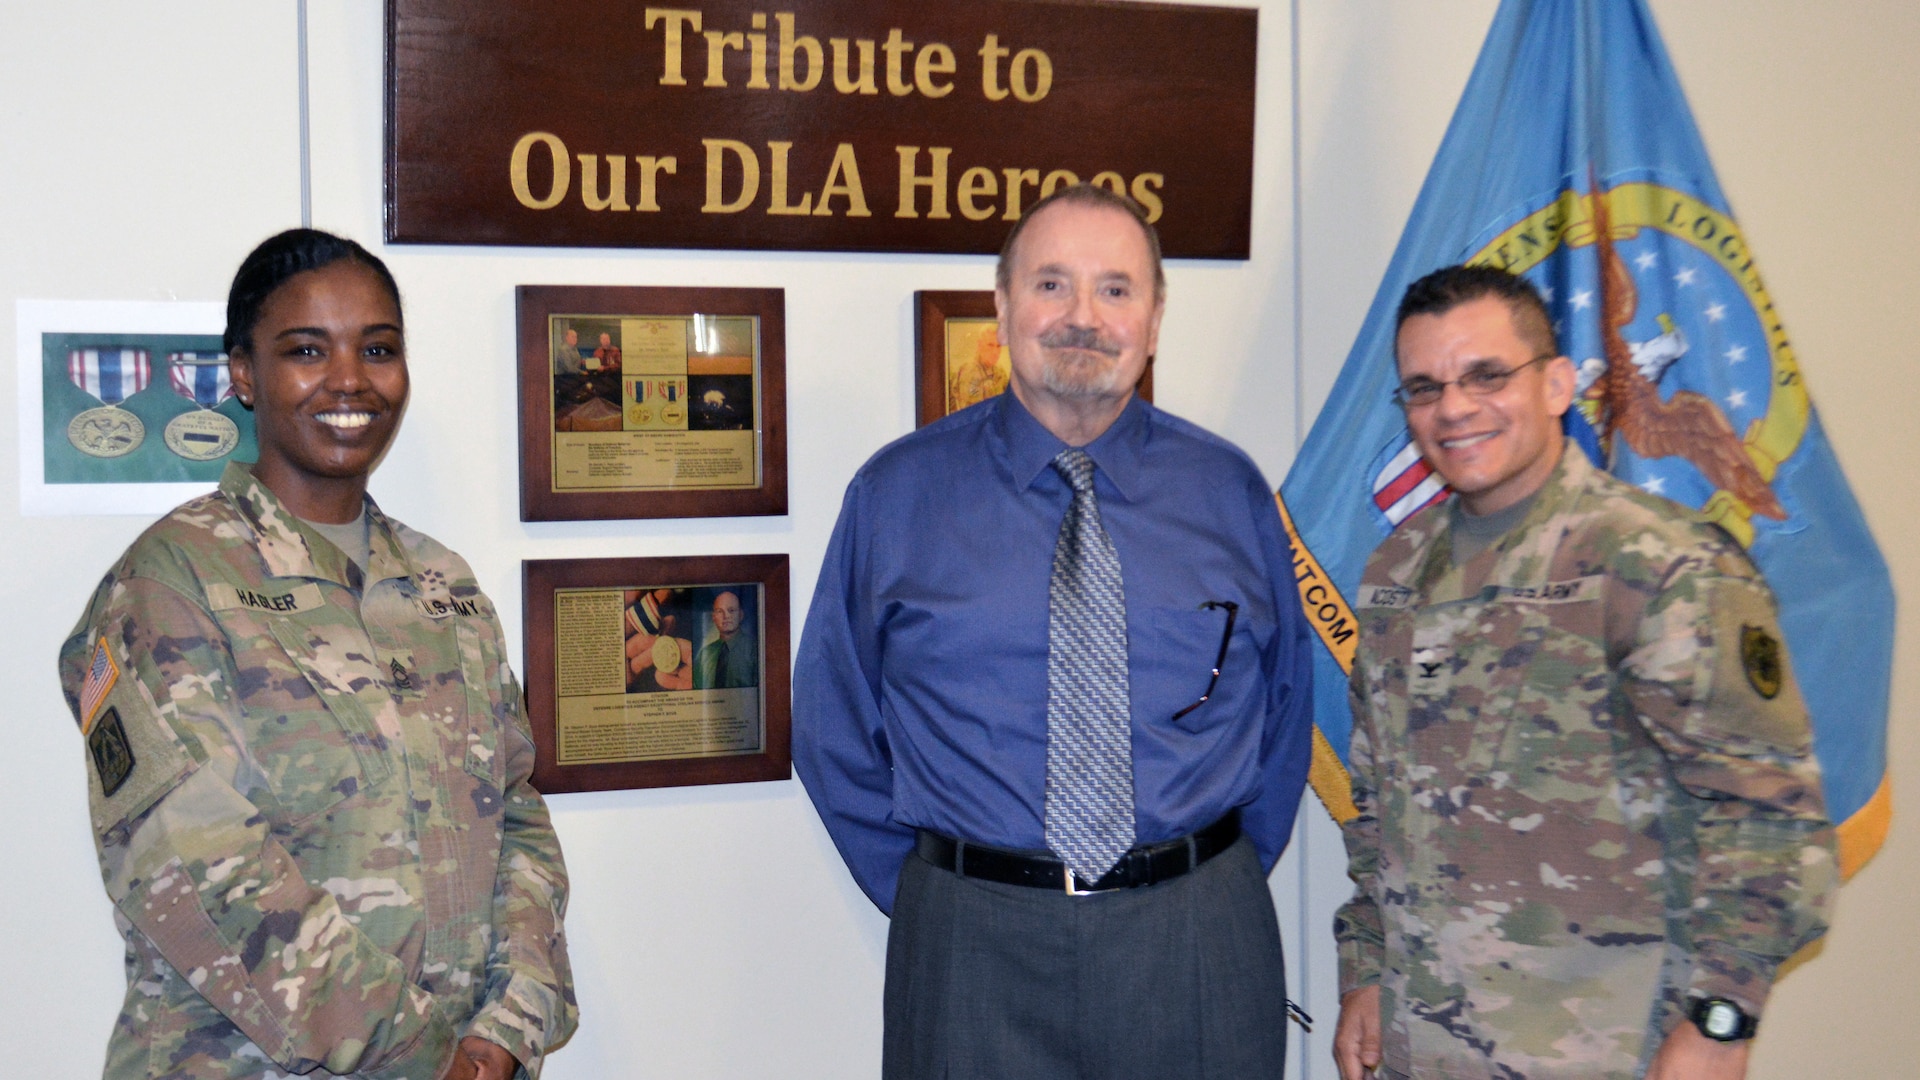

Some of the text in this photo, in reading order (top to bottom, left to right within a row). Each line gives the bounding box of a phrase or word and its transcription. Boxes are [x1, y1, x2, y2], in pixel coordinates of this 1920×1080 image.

[645, 8, 1053, 102] Tribute to
[510, 131, 677, 212] Our
[702, 138, 872, 217] DLA
